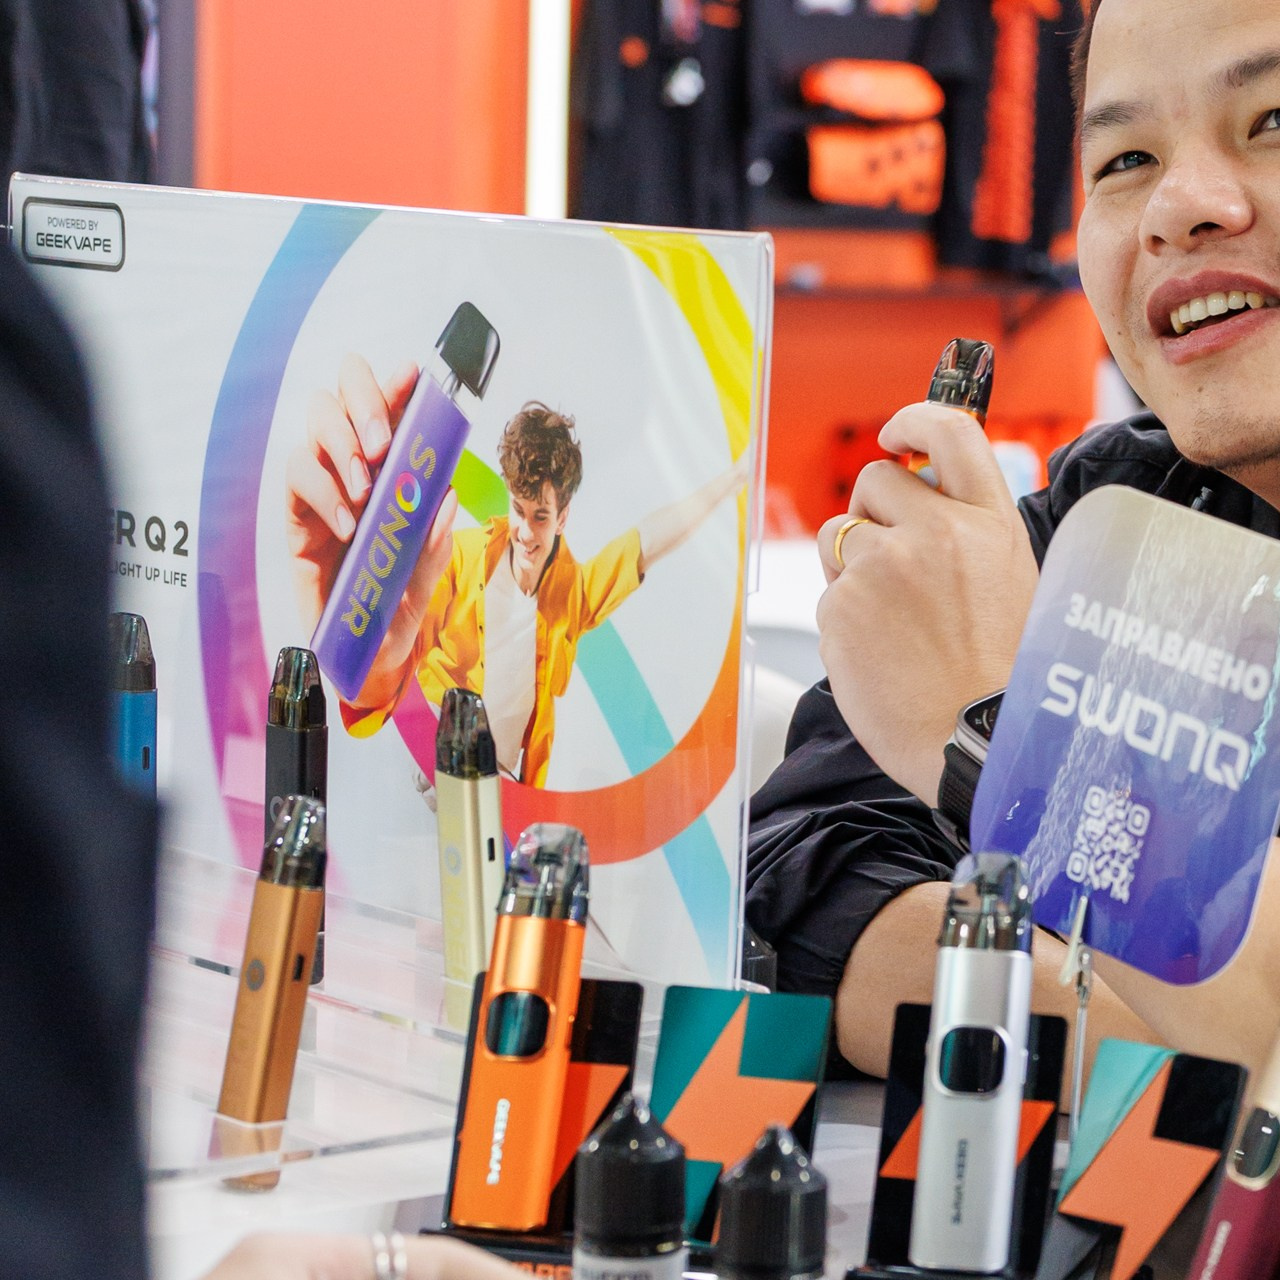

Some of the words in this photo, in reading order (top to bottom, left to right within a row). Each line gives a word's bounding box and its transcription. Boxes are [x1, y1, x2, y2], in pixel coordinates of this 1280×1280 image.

[47, 217, 87, 230] POWERED
[88, 220, 99, 231] BY
[36, 232, 112, 253] GEEKVAPE
[341, 432, 436, 637] SONDER
[145, 565, 160, 581] UP
[163, 571, 187, 588] LIFE
[1064, 592, 1271, 702] ЗАПРАВЛЕНО
